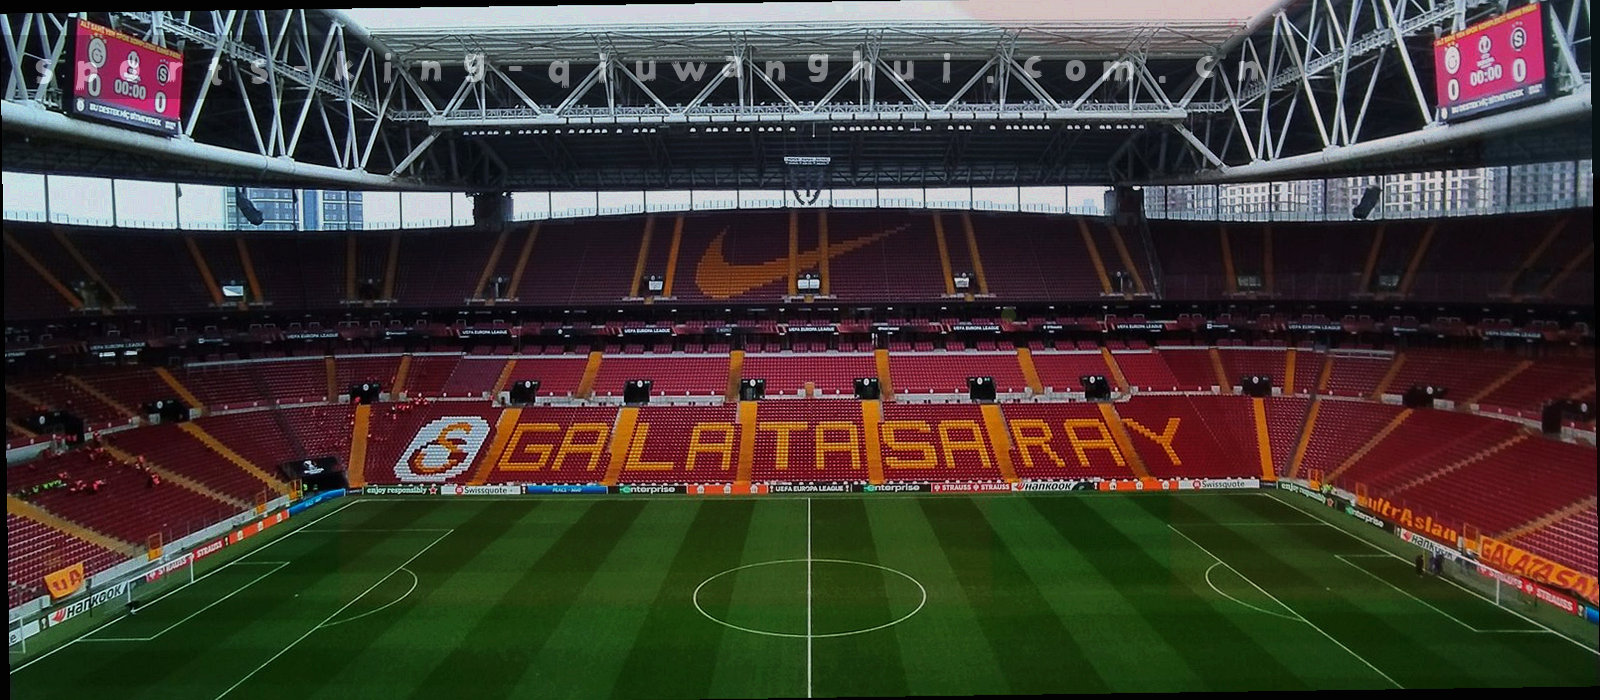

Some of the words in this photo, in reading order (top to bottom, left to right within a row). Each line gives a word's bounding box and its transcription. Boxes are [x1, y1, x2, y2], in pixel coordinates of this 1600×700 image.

[1470, 64, 1503, 86] 00:00
[1513, 58, 1526, 82] 0
[88, 73, 101, 96] 0
[114, 79, 146, 100] 00:00
[1448, 79, 1459, 100] 0
[155, 92, 166, 113] 0
[499, 417, 1182, 471] GALATASARAY
[367, 487, 386, 495] enjoy
[387, 486, 427, 495] responsibly
[464, 486, 508, 495] Swissquote
[1202, 481, 1245, 489] Swissquote
[196, 541, 223, 558] STRAUSS
[1536, 588, 1573, 611] STRAUSS
